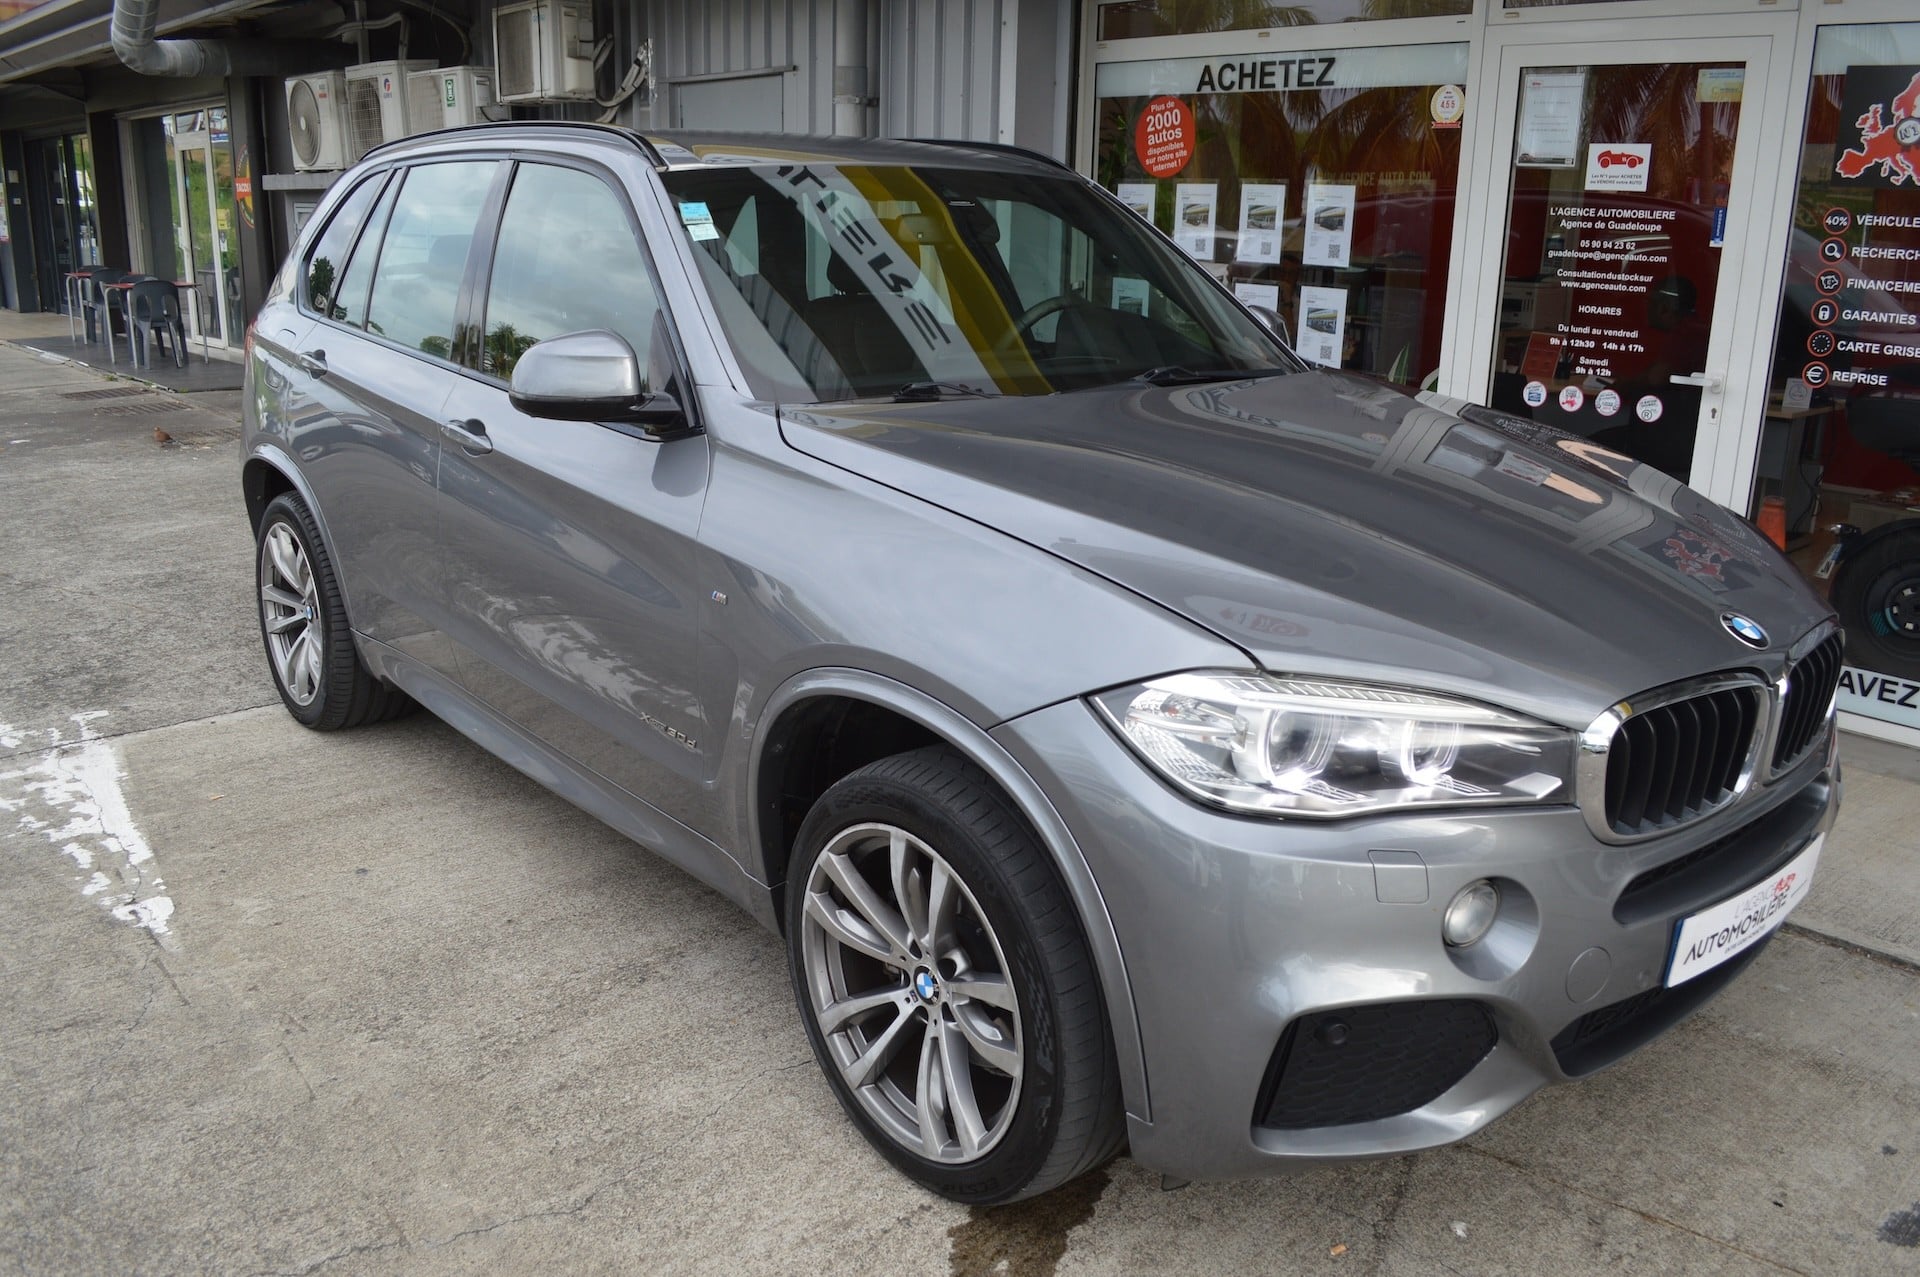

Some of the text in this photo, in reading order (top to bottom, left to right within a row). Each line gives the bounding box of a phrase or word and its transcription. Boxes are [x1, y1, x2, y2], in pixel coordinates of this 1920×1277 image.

[1196, 57, 1336, 92] ACHETEZ
[1150, 100, 1175, 113] Plus de
[1146, 108, 1181, 132] 2000
[1147, 128, 1182, 145] autos
[1147, 142, 1184, 156] disponibles
[1145, 149, 1188, 165] sur notre site
[1550, 207, 1676, 220] L'AGENCE AUTOMOBILIERE
[1560, 219, 1662, 233] Agence de Guadeloupe
[1825, 215, 1920, 228] 40% VEHICULE
[1580, 240, 1636, 250] 05 90 94 23 62
[1548, 249, 1668, 263] guadeloupe@agenceauto.com
[1560, 280, 1647, 293] www.agenceauto.com
[1578, 305, 1622, 316] HORAIRES
[1842, 310, 1917, 325] GARANTIES
[1558, 324, 1569, 332] Du
[1571, 325, 1590, 334] lundi
[1603, 328, 1639, 339] vendredi
[1550, 337, 1644, 353] 9h à 12h30 14h à 17h
[1837, 341, 1920, 358] CARTE GRISE
[1579, 356, 1609, 366] Samedi
[1575, 366, 1611, 377] 9h à 12h
[1832, 371, 1888, 386] REPRISE
[1838, 670, 1920, 709] AVEZ
[1683, 893, 1788, 965] AUTOMOBILIERE
